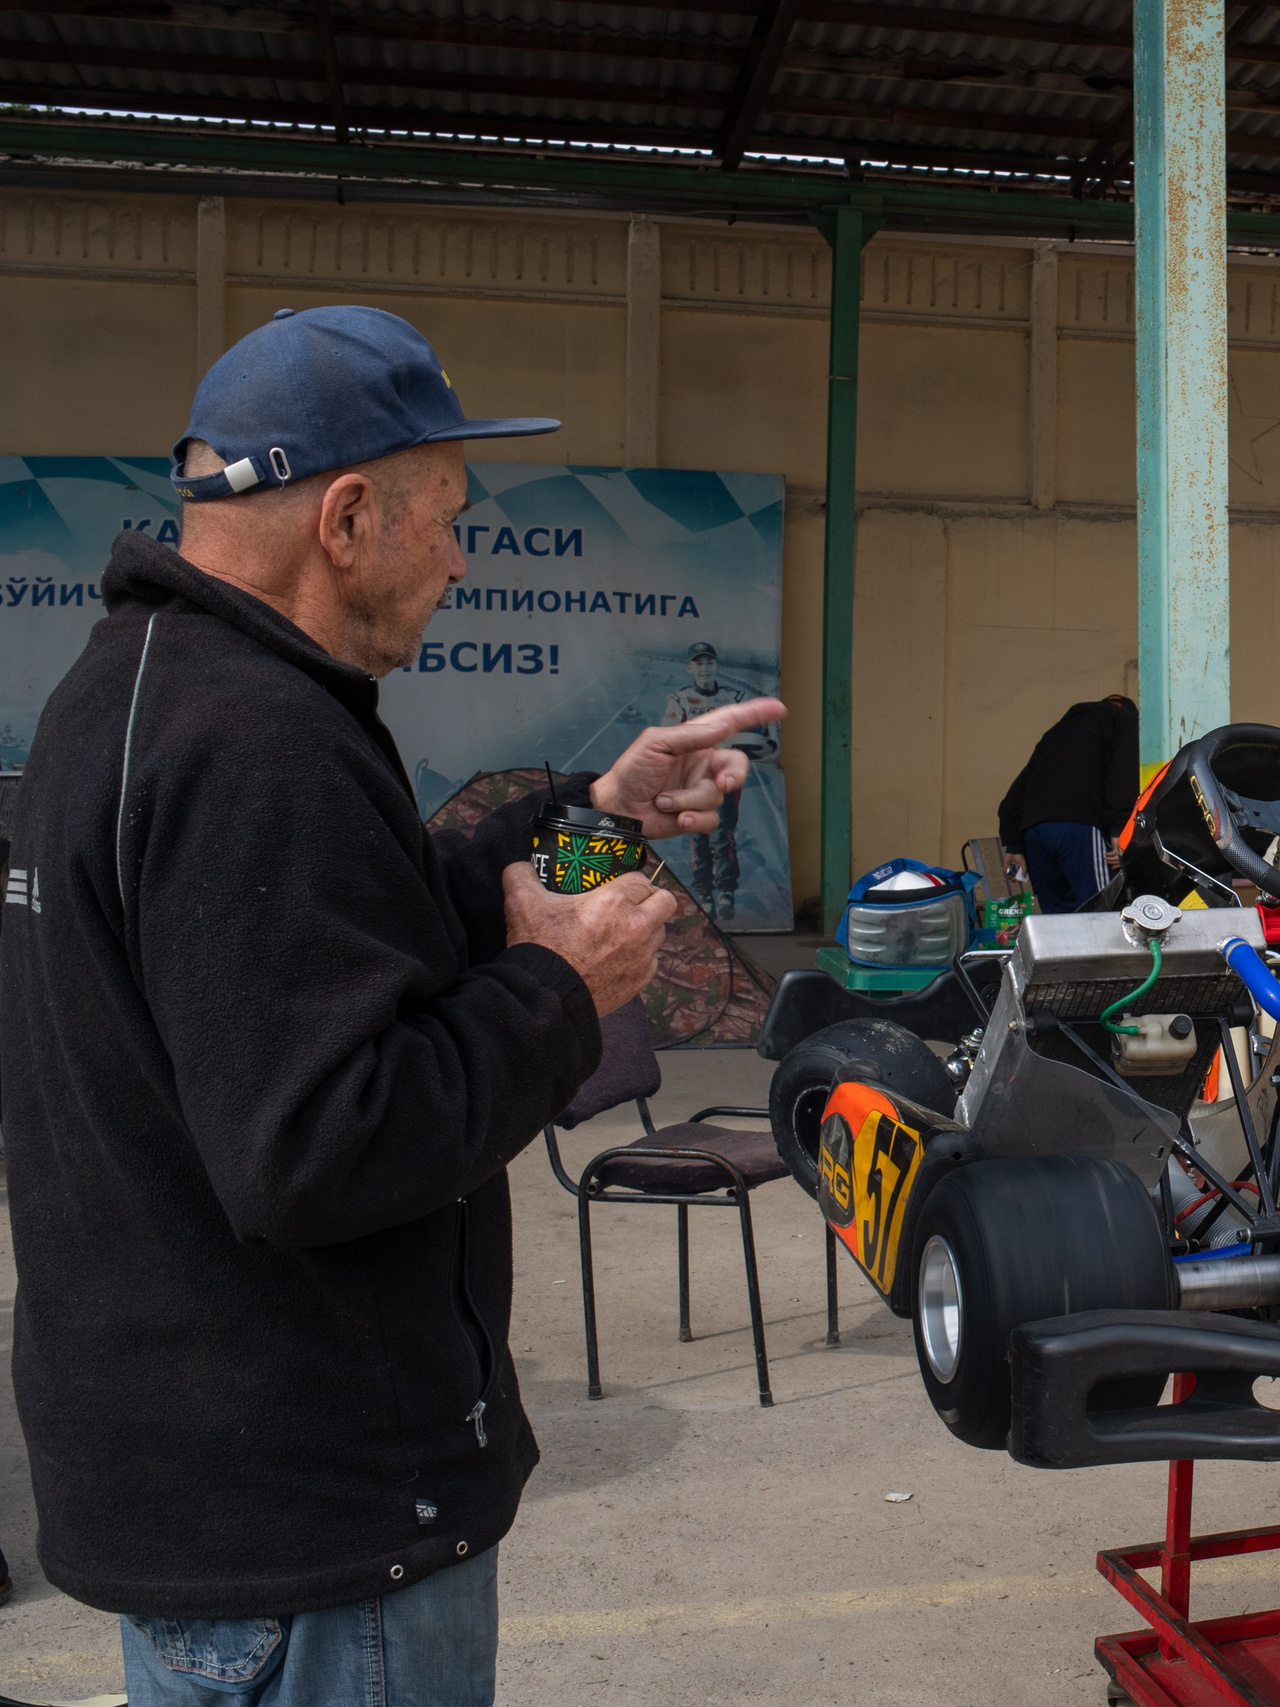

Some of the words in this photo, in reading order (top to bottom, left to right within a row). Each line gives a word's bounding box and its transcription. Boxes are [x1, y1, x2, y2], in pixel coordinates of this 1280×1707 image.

[403, 641, 560, 675] БСИЗ!
[818, 1140, 850, 1210] RG
[863, 1113, 918, 1285] 57
